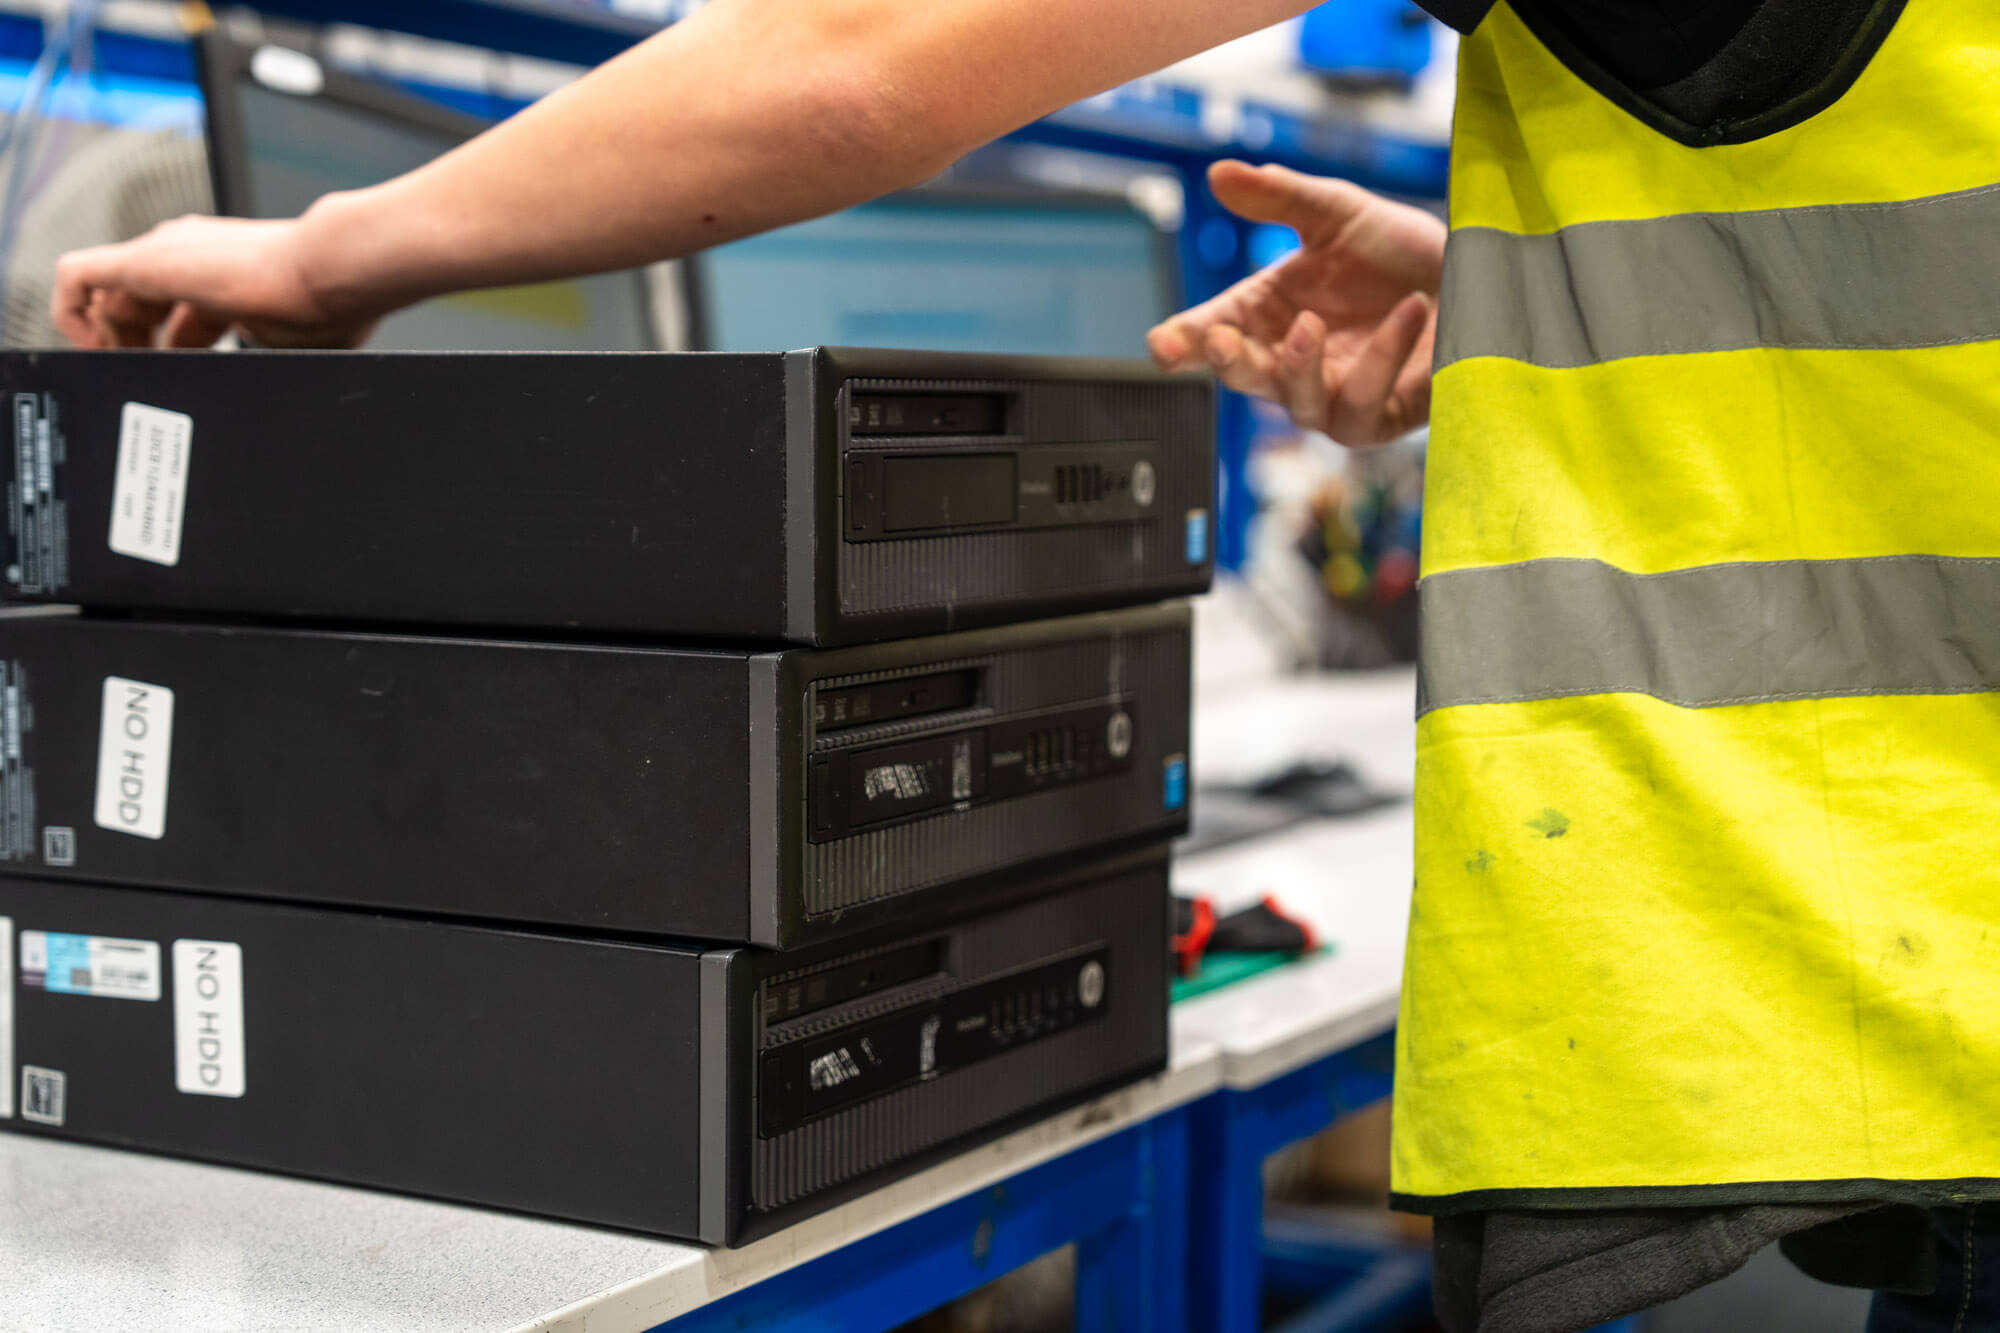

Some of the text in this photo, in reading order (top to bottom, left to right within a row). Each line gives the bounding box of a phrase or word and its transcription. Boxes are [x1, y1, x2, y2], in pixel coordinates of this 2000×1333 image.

[119, 686, 149, 825] NO HDD
[196, 947, 222, 1086] NO HDD
